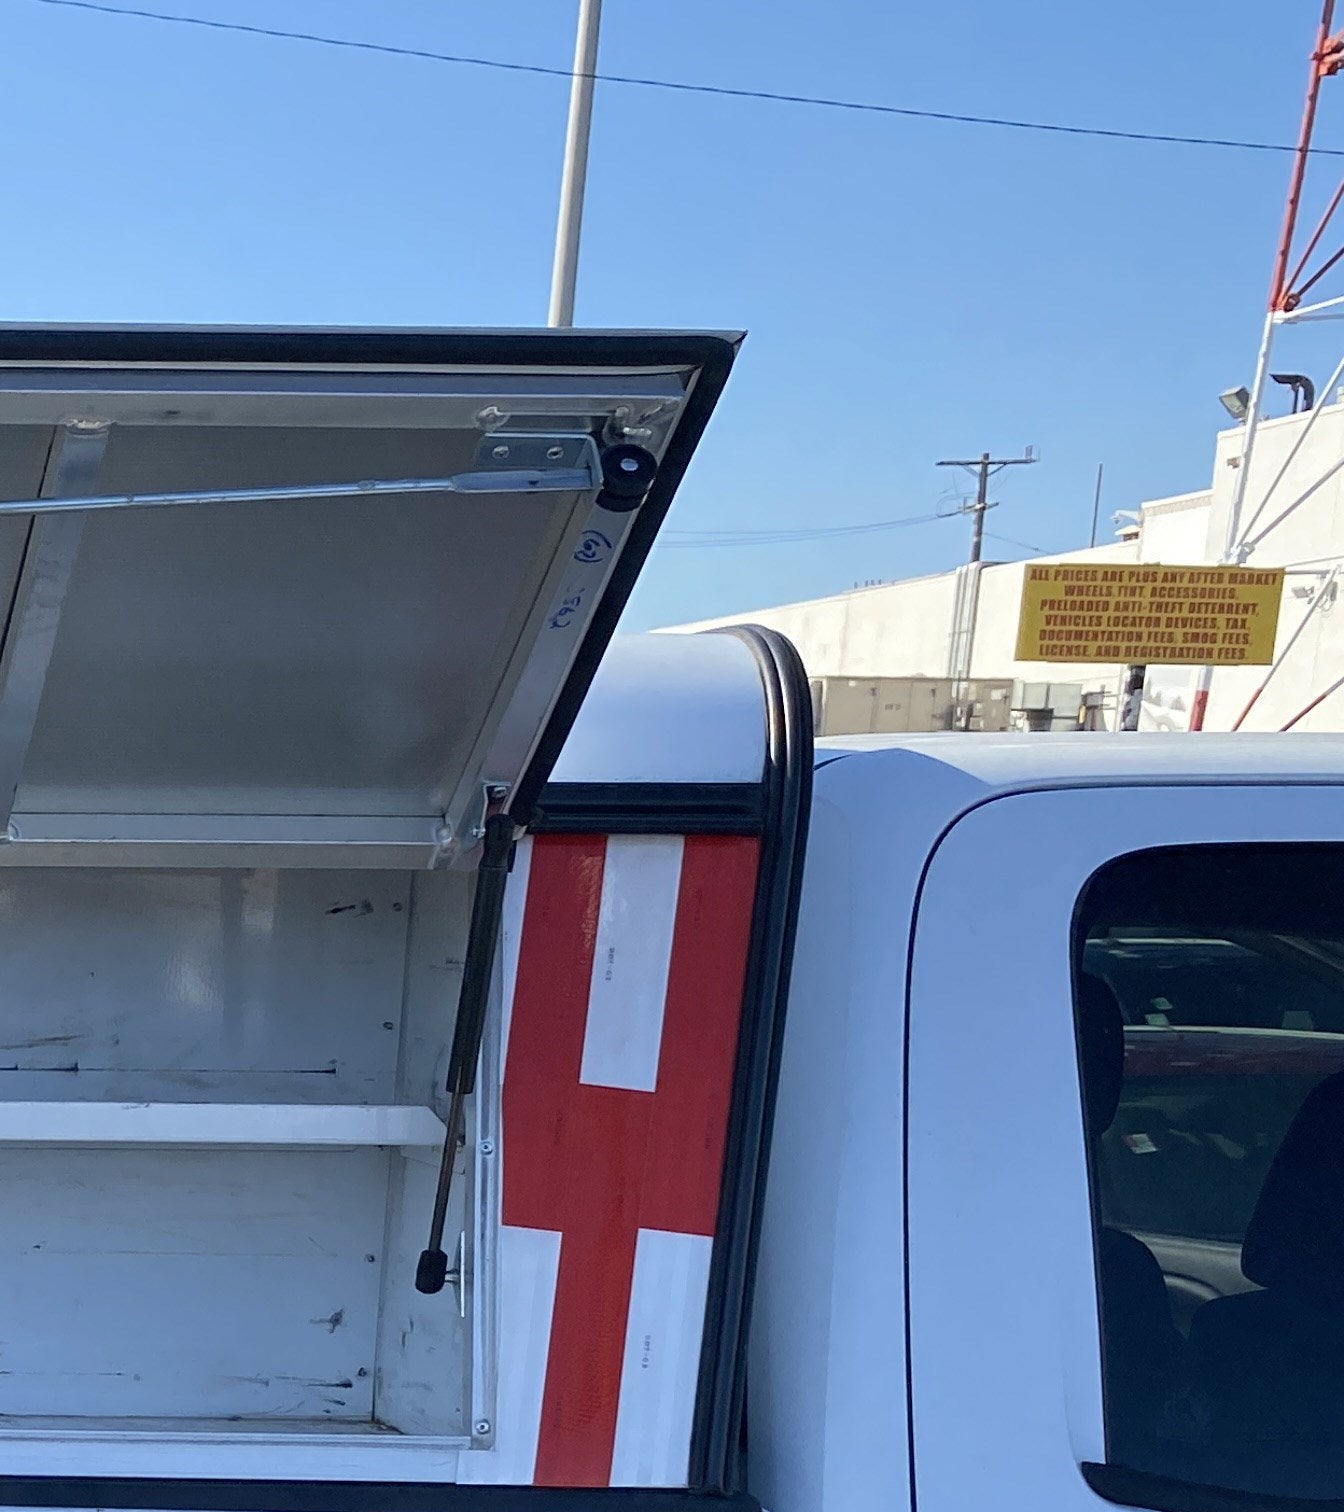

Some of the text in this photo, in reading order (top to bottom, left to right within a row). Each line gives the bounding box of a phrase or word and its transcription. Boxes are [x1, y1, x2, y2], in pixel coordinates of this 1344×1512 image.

[1030, 569, 1278, 585] ALL PRICES ARE PLUS ANY AFTER MARKET
[1040, 599, 1260, 617] PRELOADED ANTI-THEFT DETERRENT,
[1045, 614, 1103, 627] VEHICLES
[1107, 616, 1161, 628] LOCATOR
[1039, 629, 1143, 642] DOCUMENTATION
[1181, 632, 1217, 644] SMOG
[1094, 645, 1121, 658] AND
[1124, 646, 1214, 659] REGISTRATION
